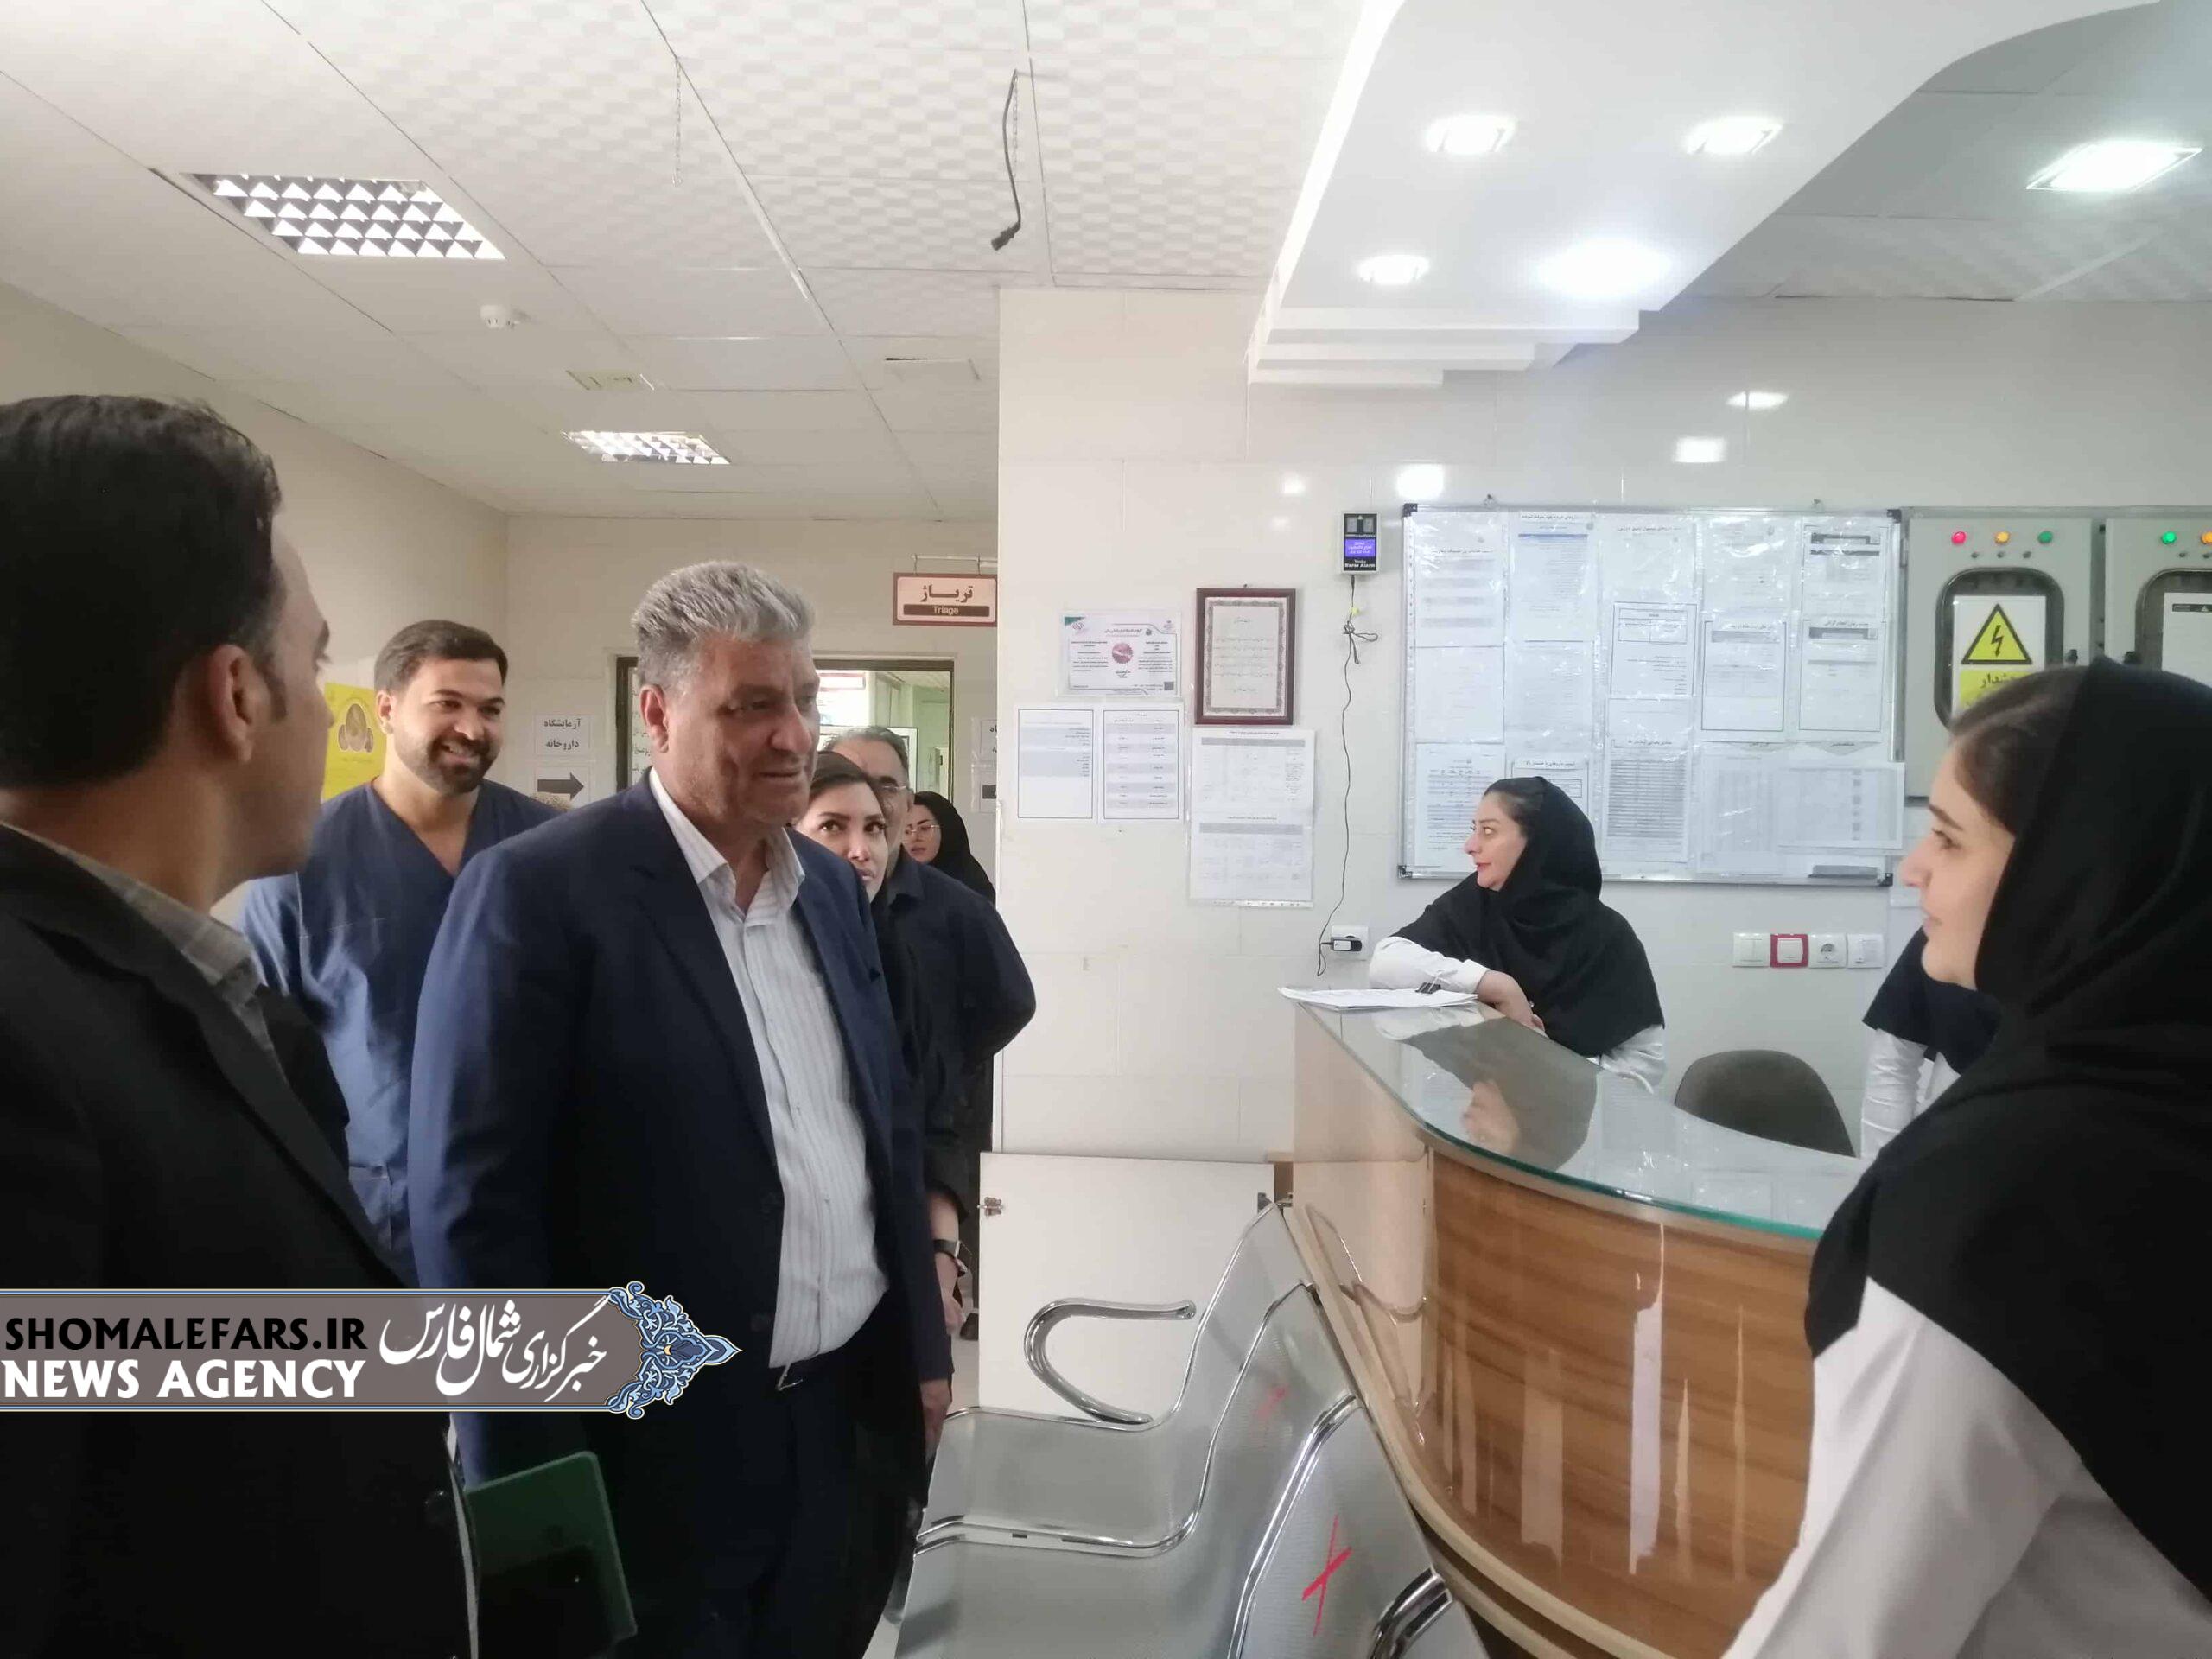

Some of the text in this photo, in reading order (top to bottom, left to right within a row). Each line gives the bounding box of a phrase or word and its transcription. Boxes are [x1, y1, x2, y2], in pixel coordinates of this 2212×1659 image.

[920, 584, 974, 603] تریاژ
[933, 606, 960, 615] Triage
[543, 718, 581, 730] آزمایشگاه
[545, 739, 580, 751] داروخانه
